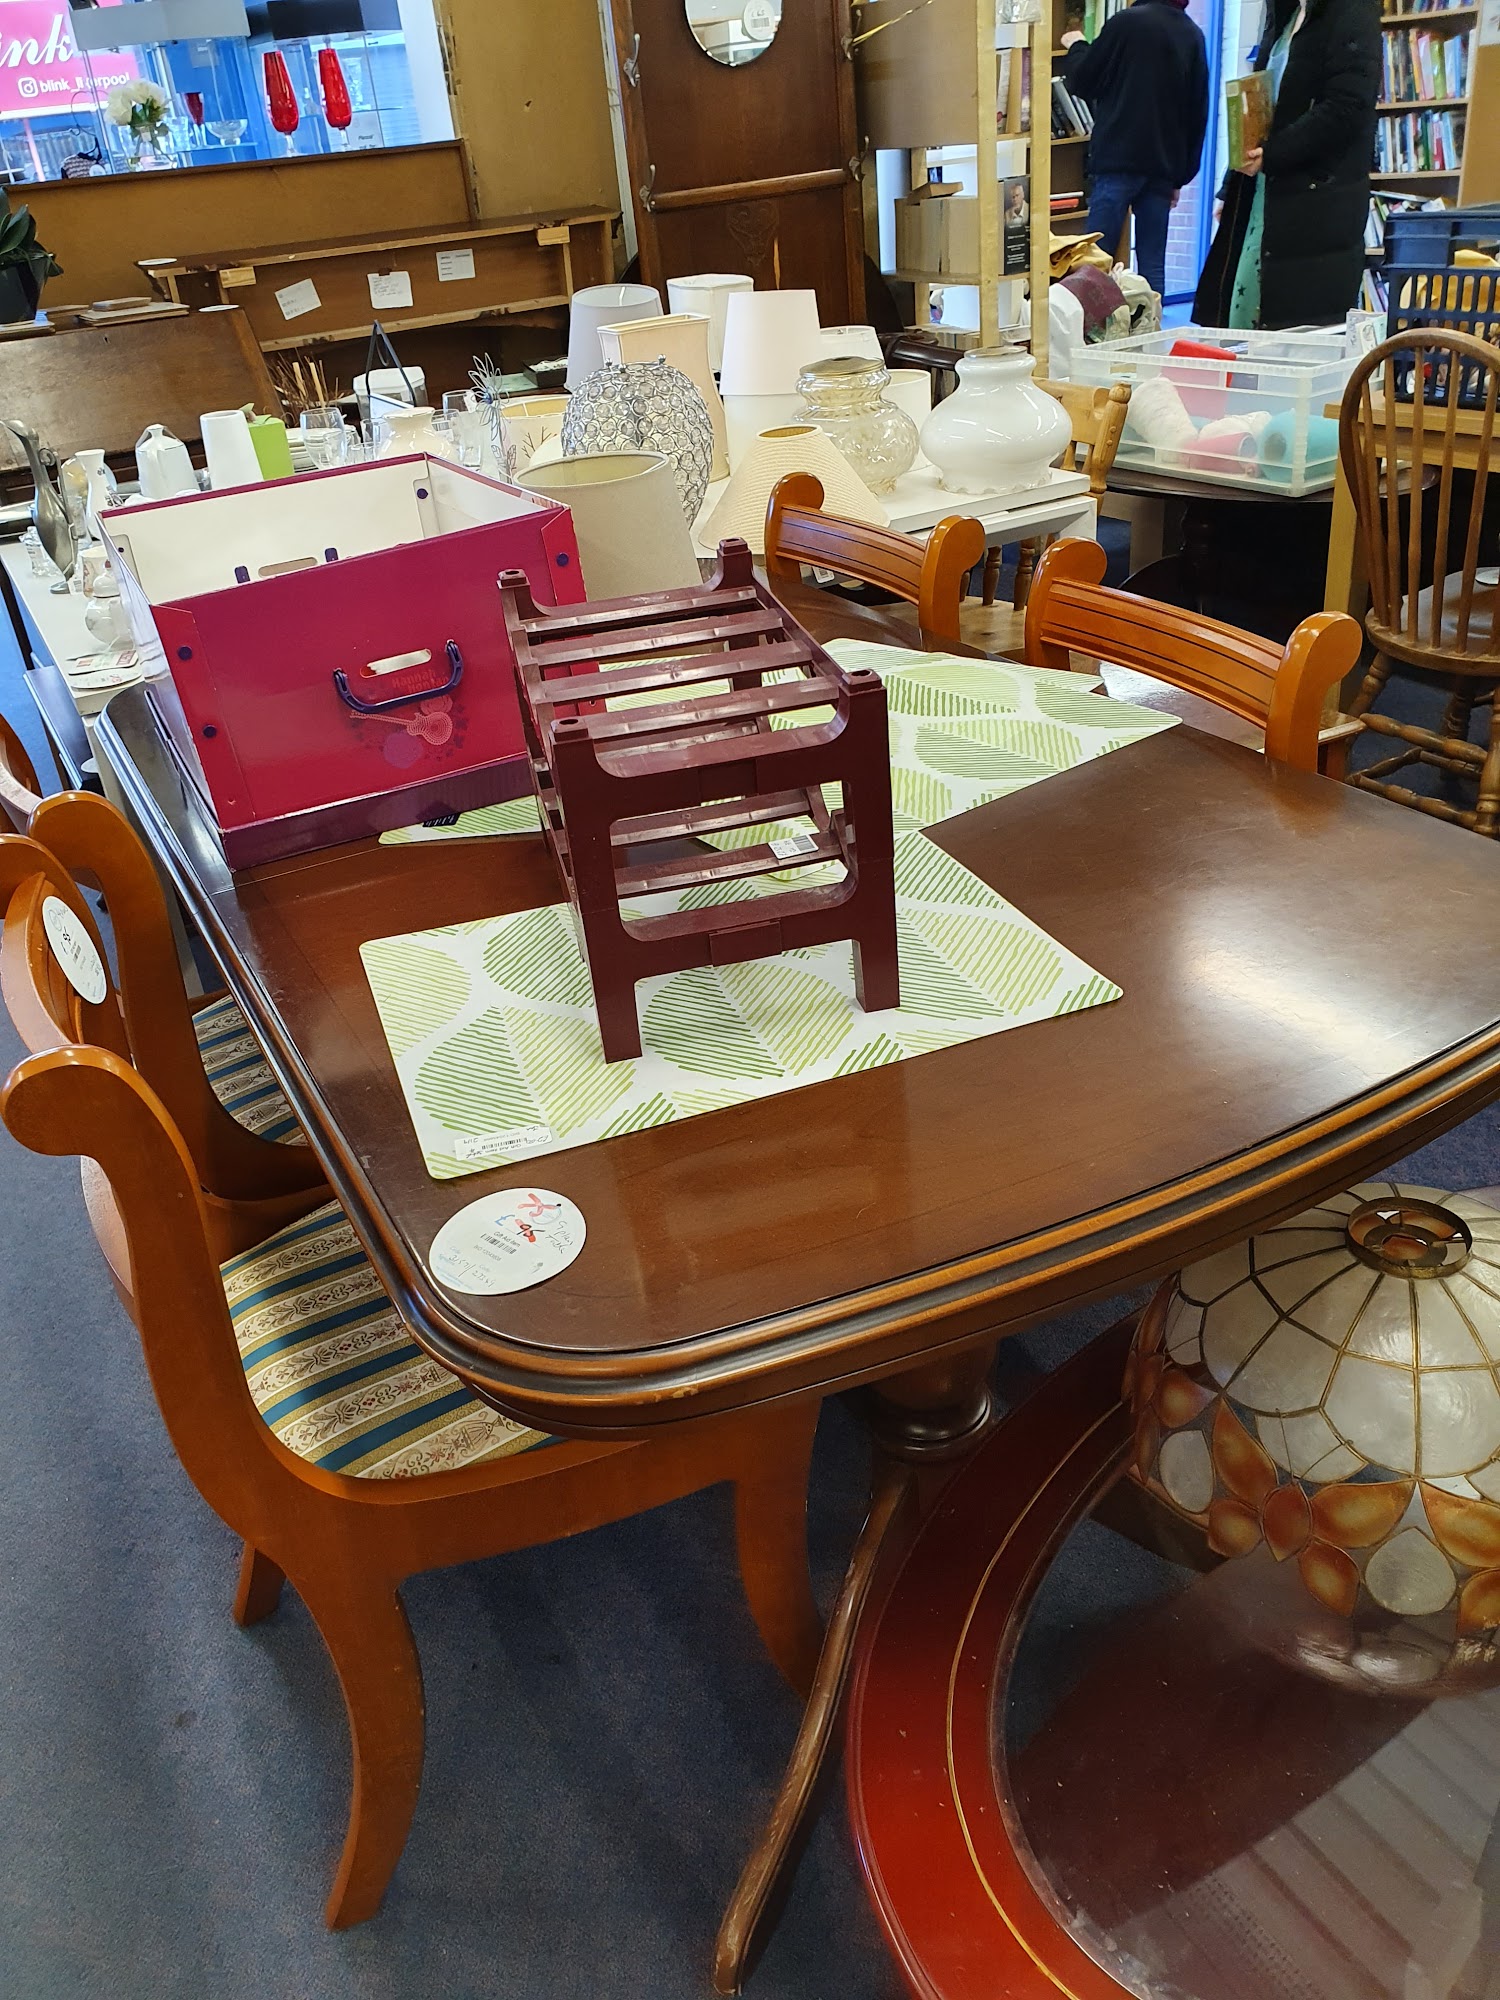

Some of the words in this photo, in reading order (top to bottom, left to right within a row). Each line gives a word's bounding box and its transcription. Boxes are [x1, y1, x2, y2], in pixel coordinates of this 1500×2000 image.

[0, 13, 73, 68] nk
[392, 669, 437, 688] Hannah
[407, 675, 450, 694] Montan
